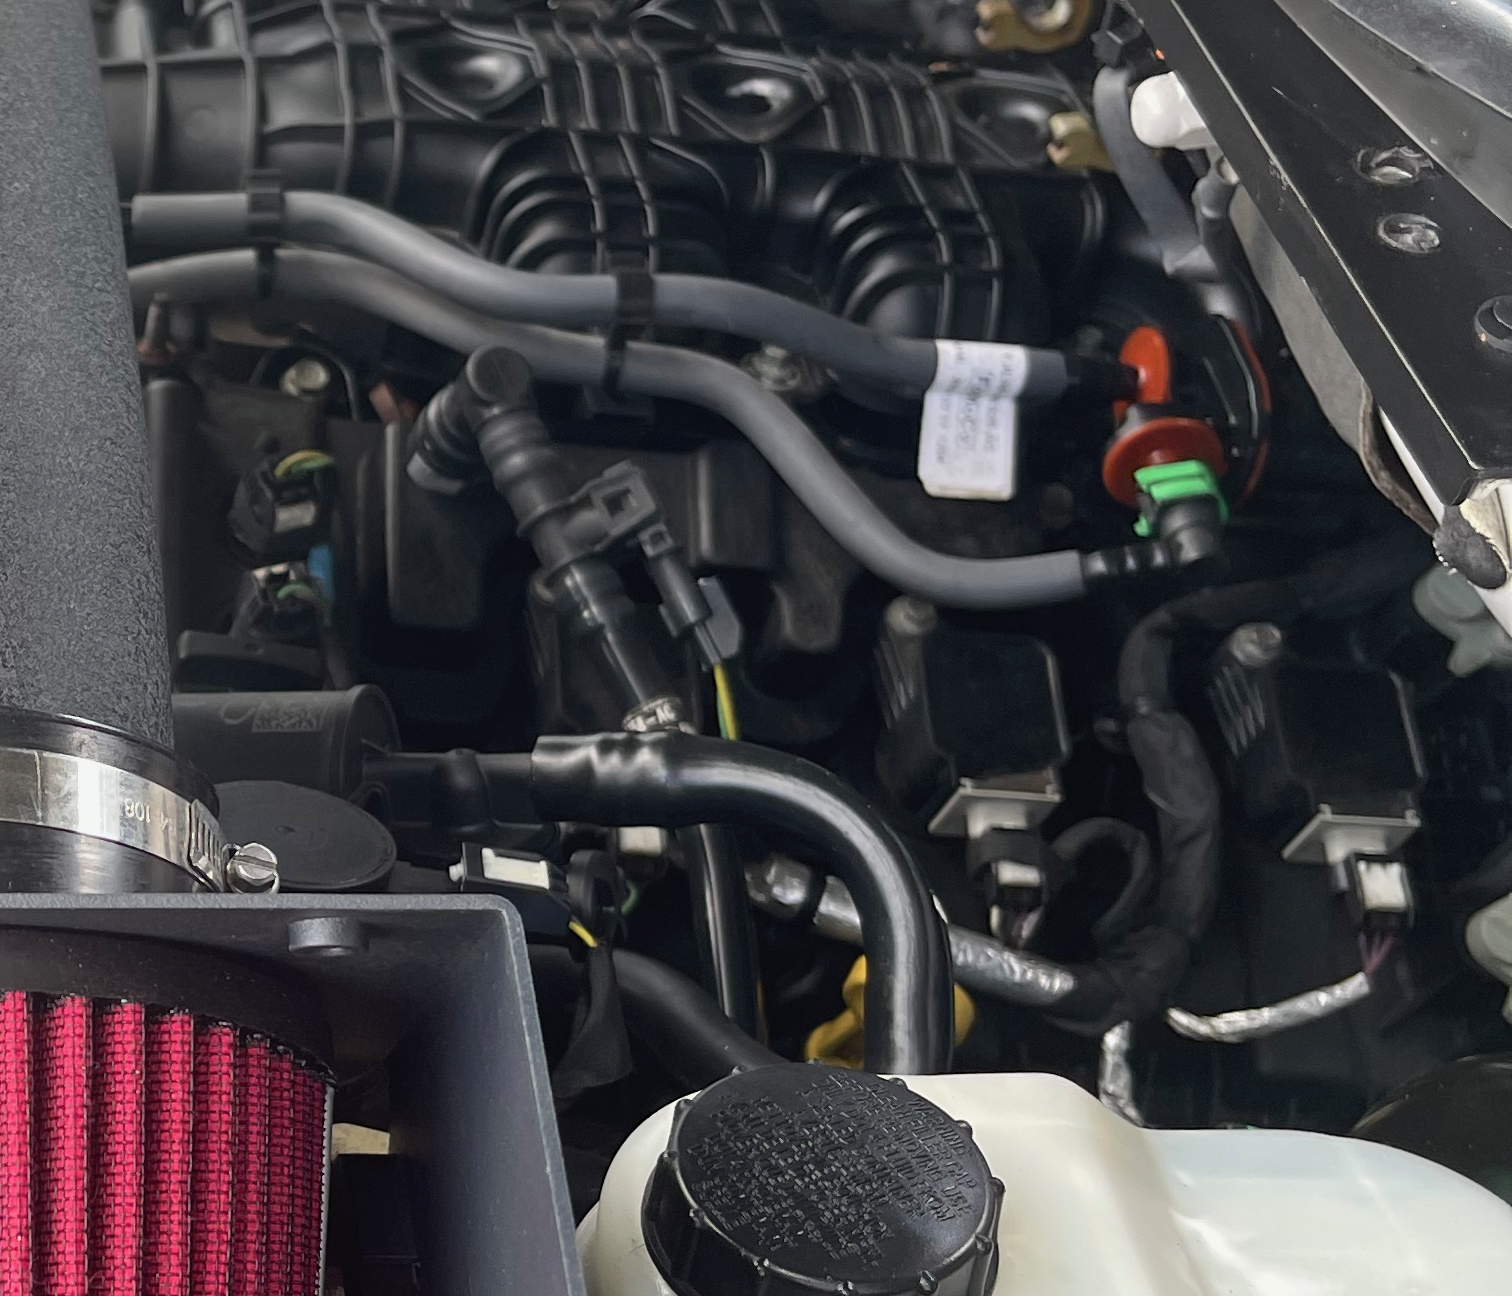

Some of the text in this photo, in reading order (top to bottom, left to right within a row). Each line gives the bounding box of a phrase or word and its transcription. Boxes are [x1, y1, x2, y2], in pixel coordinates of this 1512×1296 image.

[943, 1161, 978, 1190] CAP
[909, 1180, 958, 1222] FROM
[938, 1184, 978, 1216] USE
